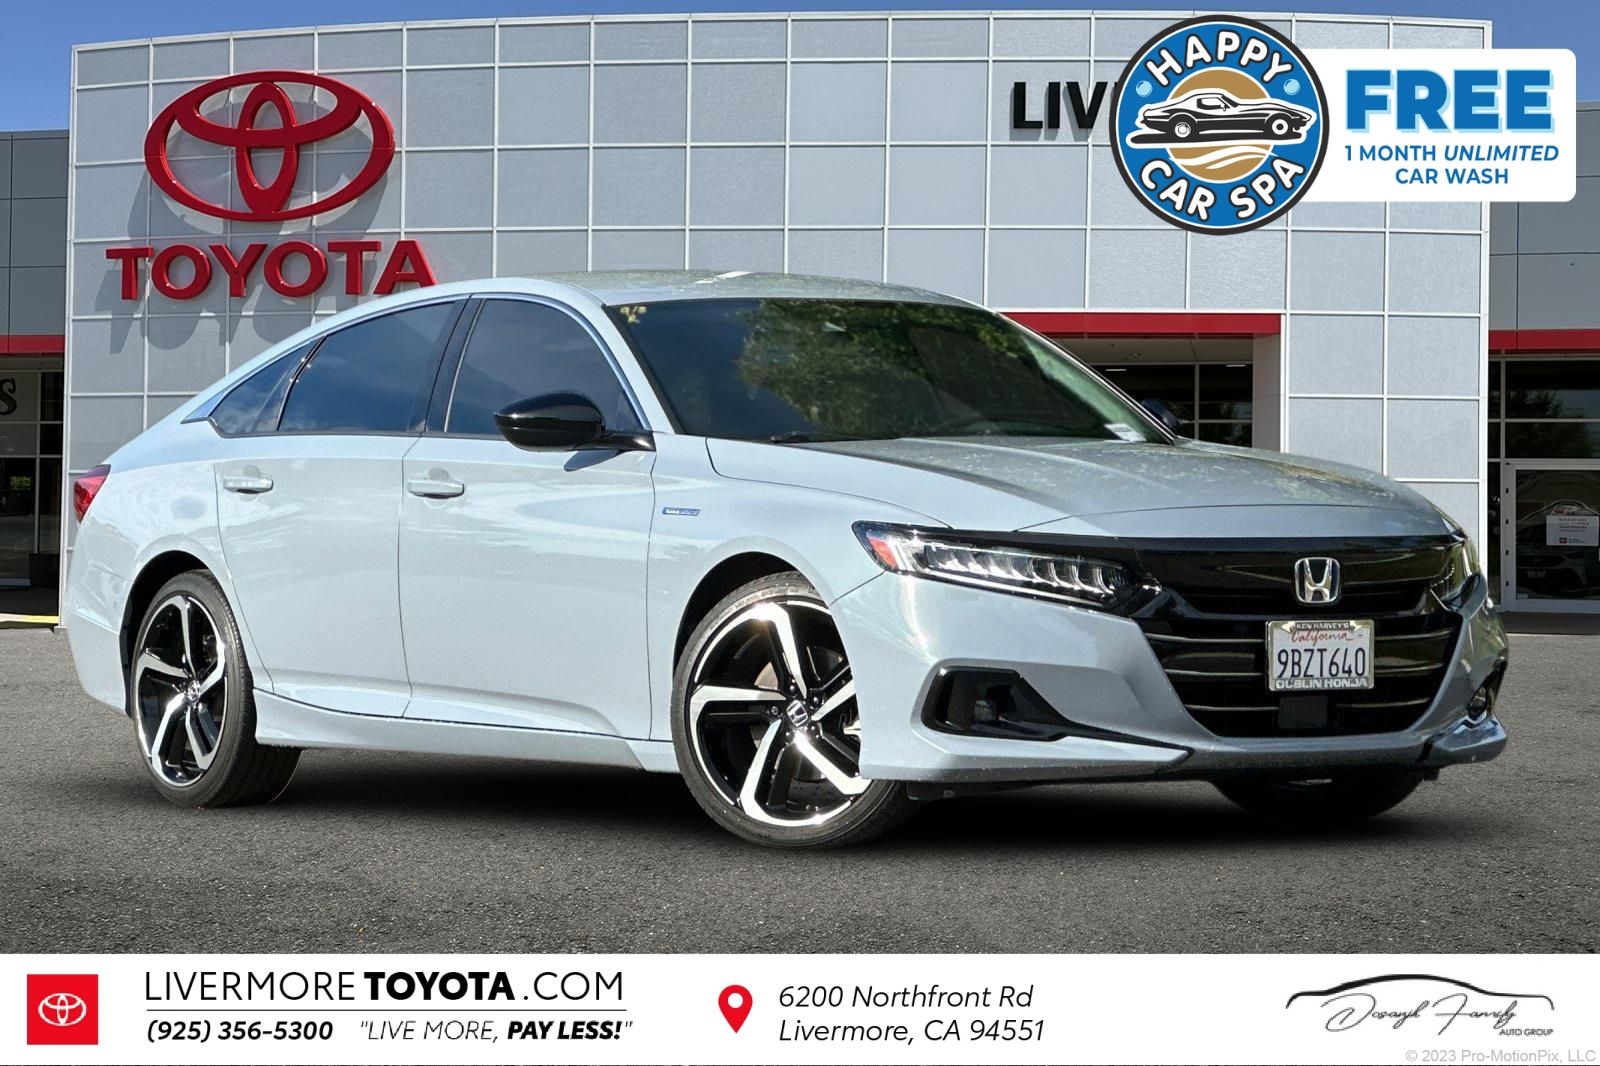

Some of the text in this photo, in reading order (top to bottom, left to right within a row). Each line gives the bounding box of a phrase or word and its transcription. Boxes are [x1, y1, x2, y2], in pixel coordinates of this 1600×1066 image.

[1013, 82, 1119, 128] LIV
[106, 240, 437, 300] TOYOTA
[1292, 629, 1353, 646] California
[1277, 647, 1366, 678] 9BZT640
